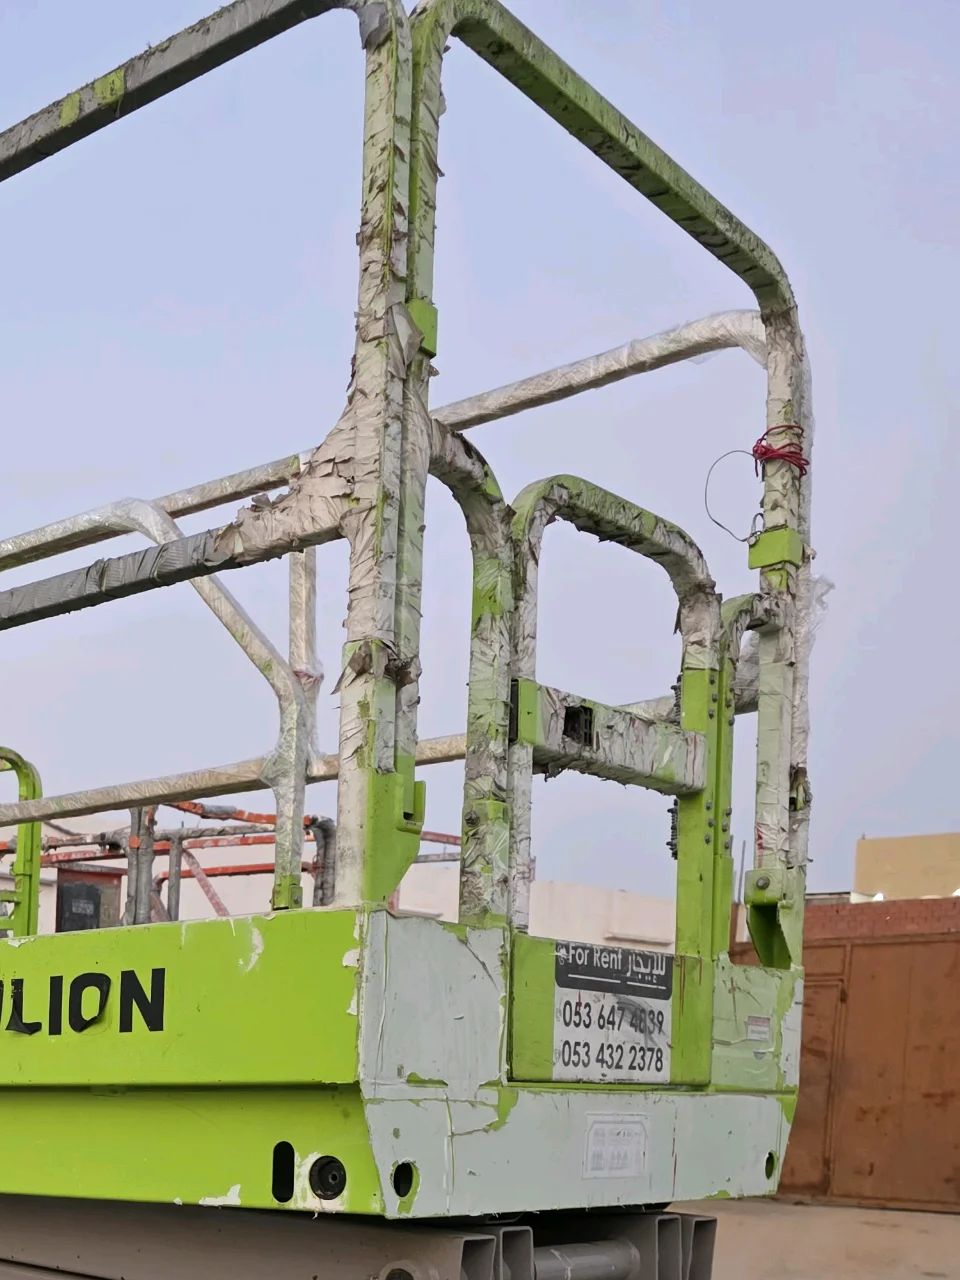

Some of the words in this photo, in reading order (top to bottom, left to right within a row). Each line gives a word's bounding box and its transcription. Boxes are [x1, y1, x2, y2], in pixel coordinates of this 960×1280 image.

[568, 943, 589, 966] For
[593, 947, 622, 970] Rent
[562, 1000, 592, 1029] 053
[597, 1004, 625, 1031] 647
[561, 1039, 591, 1068] 053
[595, 1042, 624, 1070] 432
[628, 1045, 664, 1073] 2378
